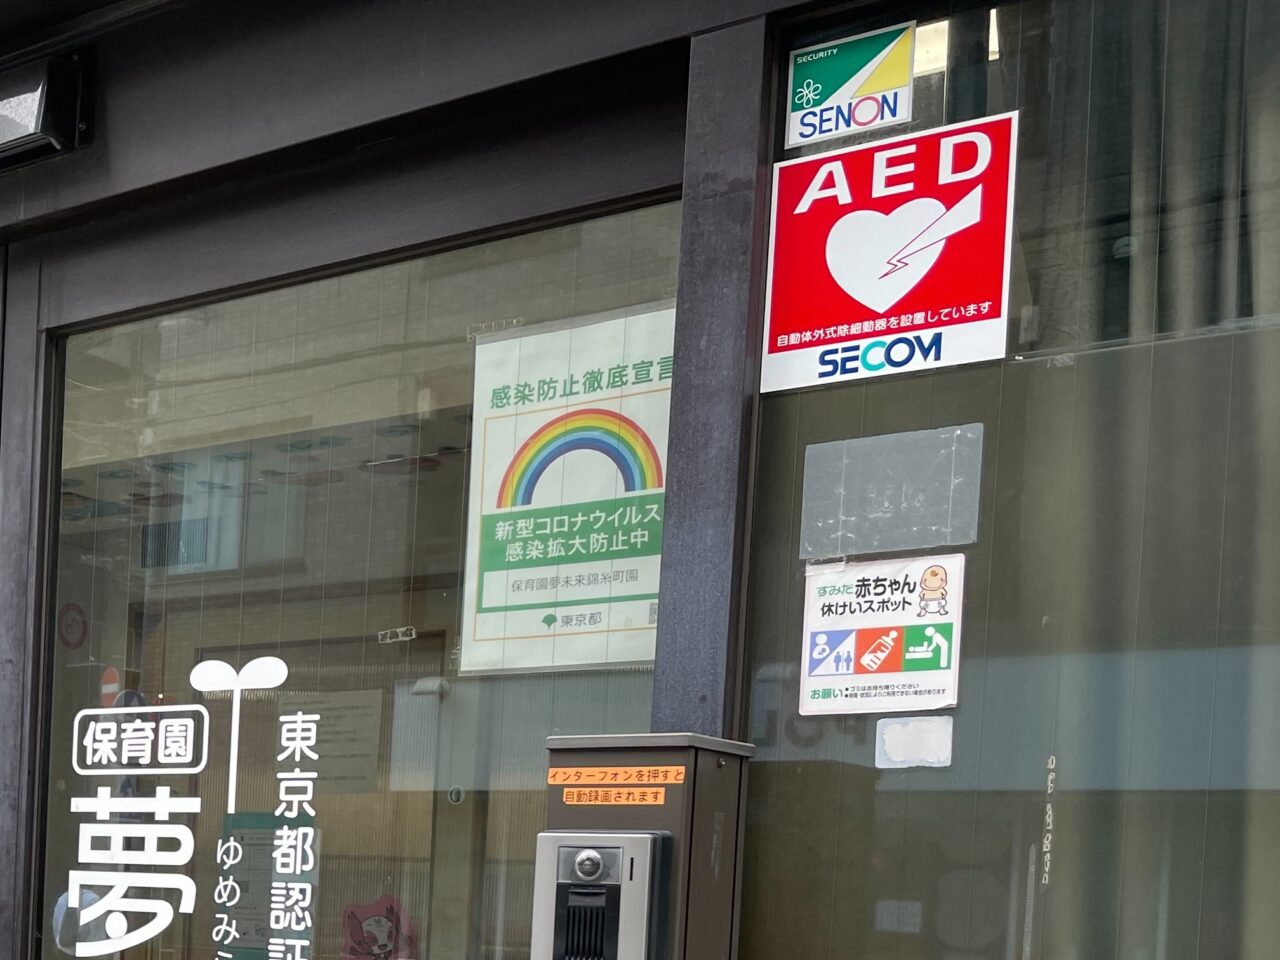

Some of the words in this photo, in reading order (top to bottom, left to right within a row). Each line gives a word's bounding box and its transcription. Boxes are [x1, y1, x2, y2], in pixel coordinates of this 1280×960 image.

[797, 48, 838, 64] SECURITY
[799, 91, 898, 138] SENON
[793, 131, 992, 214] AED
[777, 301, 992, 347] 自動体外式除細動器を設置しています
[818, 332, 943, 378] SECOM
[490, 356, 674, 409] 感染防止徹底宣言
[495, 504, 661, 542] 新型コロナウイルス
[505, 528, 649, 562] 感染拡大防止中
[511, 569, 638, 593] 保育園夢未来錦糸町園
[817, 584, 854, 597] すみだ
[855, 574, 917, 599] 赤ちゃん
[560, 611, 602, 628] 東京都
[821, 597, 912, 617] 休けいスポット
[810, 688, 843, 700] お願い
[83, 718, 196, 765] 保育園
[549, 767, 684, 784] インターフォンを押すと
[564, 788, 663, 804] 自動録画されます
